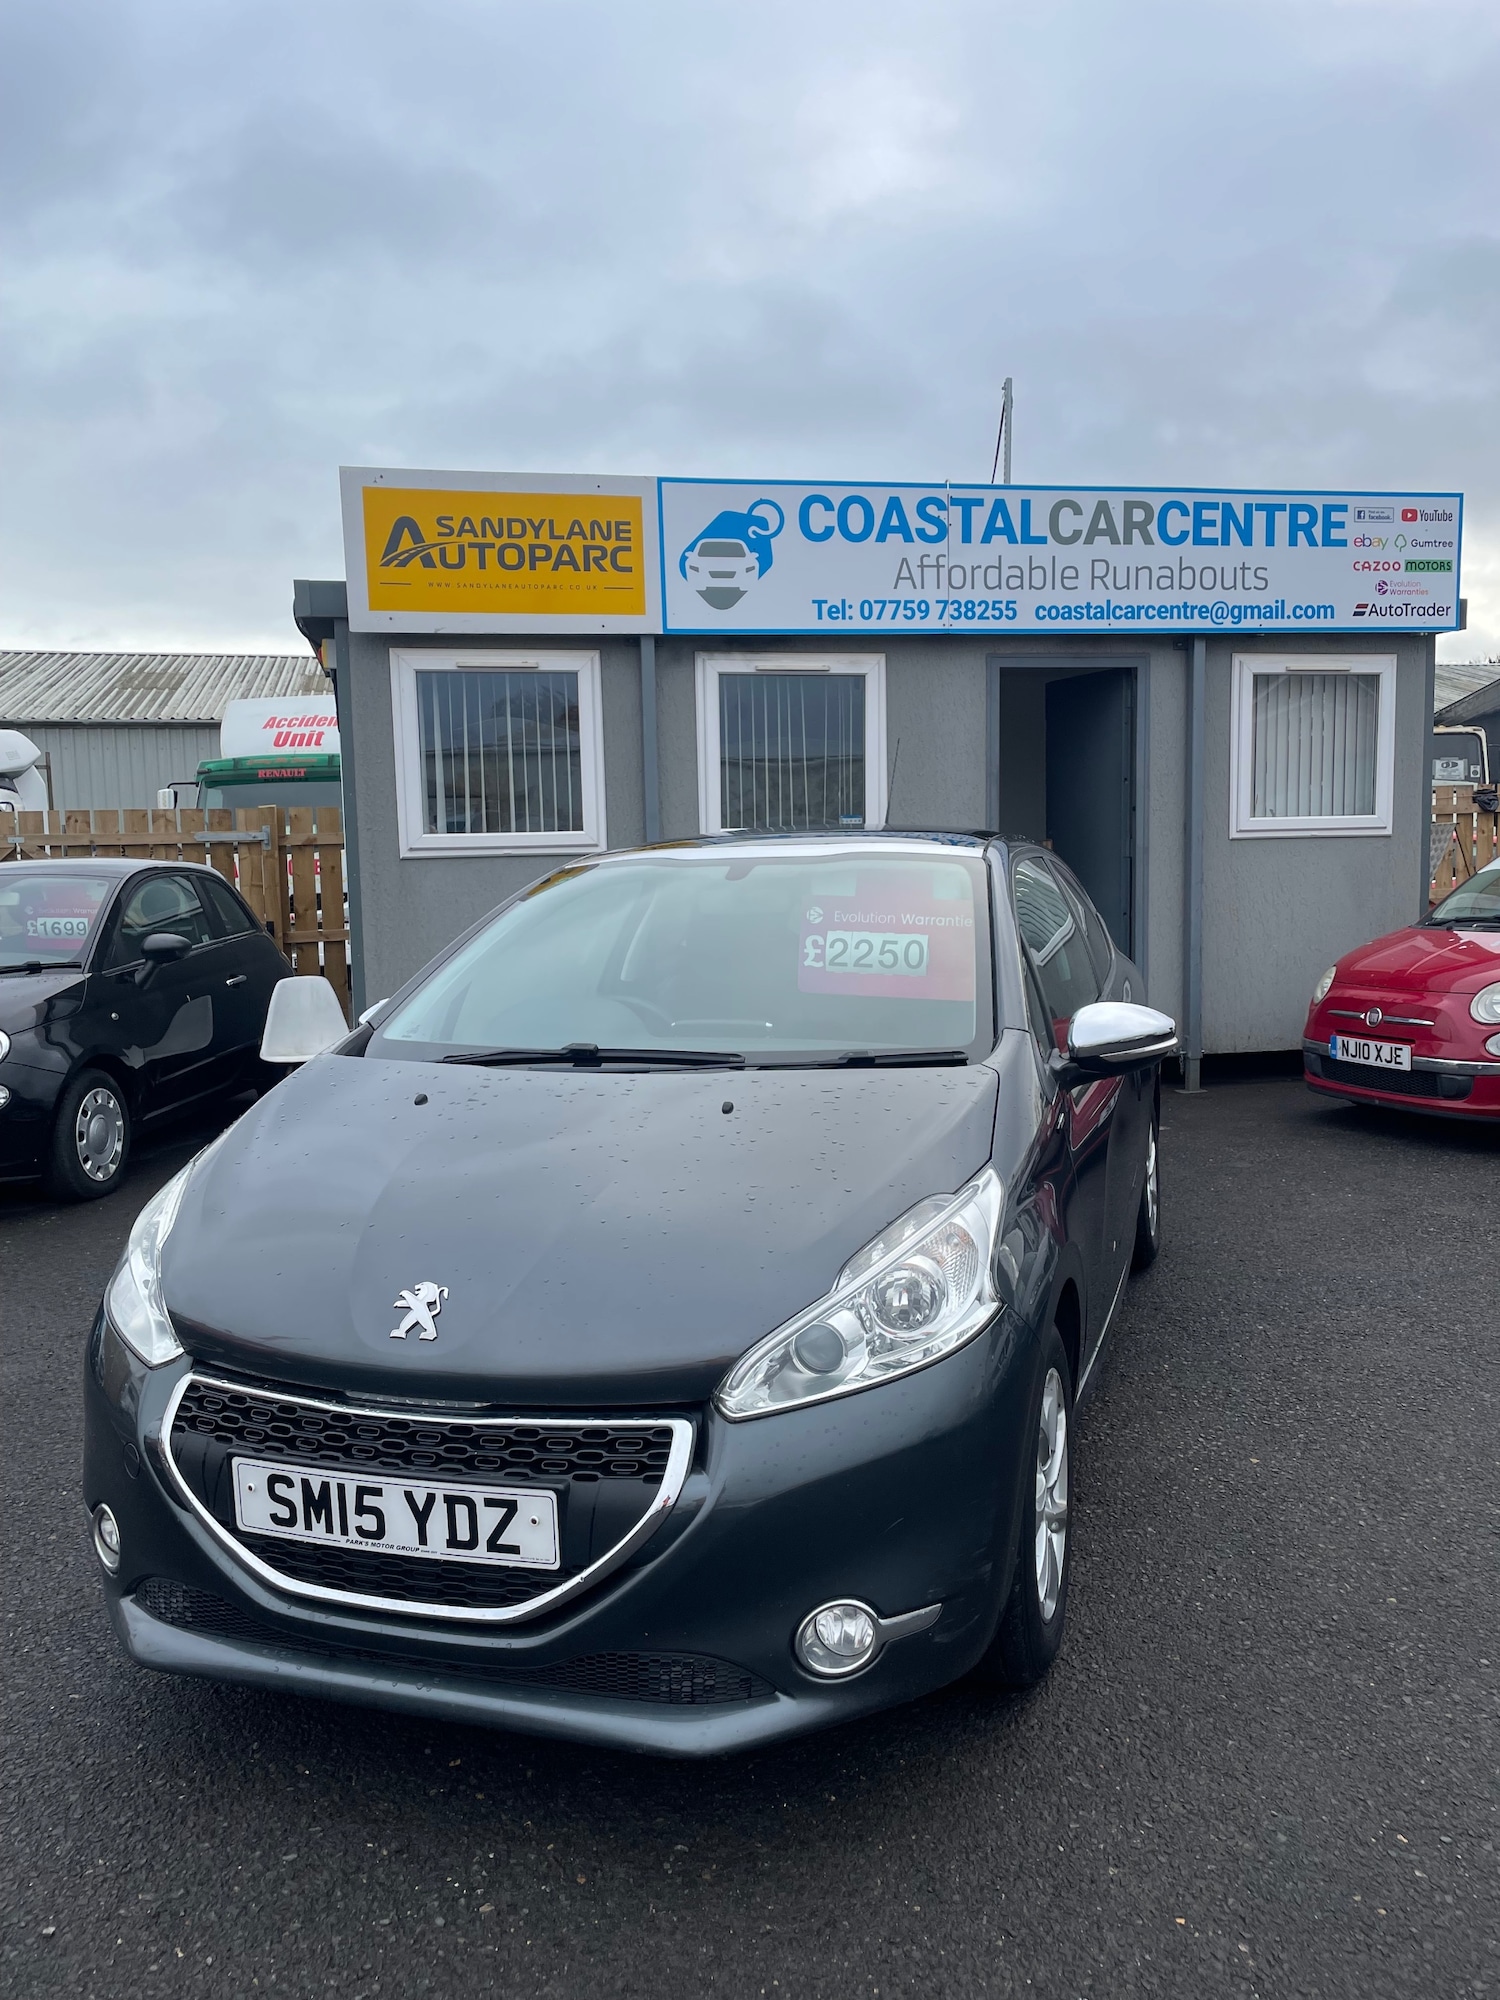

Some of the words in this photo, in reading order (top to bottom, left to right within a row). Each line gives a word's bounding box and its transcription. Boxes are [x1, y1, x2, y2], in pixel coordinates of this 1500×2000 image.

[1420, 509, 1453, 522] YouTube
[435, 516, 632, 541] SANDYLANE
[380, 516, 633, 573] AUTOPARC
[1353, 534, 1389, 551] ebay
[1411, 539, 1453, 548] Gumtree
[893, 554, 1079, 591] Affordable
[1090, 556, 1269, 591] Runabouts
[1353, 561, 1401, 572] CAZOO
[1406, 561, 1452, 571] MOTORS
[812, 599, 853, 620] Tel:
[859, 599, 930, 621] 07759
[936, 600, 1017, 621] 738255
[1035, 599, 1335, 625] coastalcarcentre@gmail.com
[1368, 602, 1451, 617] AutoTrader
[262, 714, 337, 729] Acciden
[273, 730, 325, 748] Unit
[257, 768, 306, 778] RENAULT
[834, 911, 896, 924] Evolution
[901, 913, 973, 927] Warrantie
[27, 920, 87, 937] £1699
[803, 934, 925, 970] £2250
[1341, 1039, 1371, 1061] NJ10
[1374, 1044, 1404, 1066] XJE
[266, 1473, 386, 1541] SM15
[403, 1489, 521, 1555] YDZ
[345, 1538, 369, 1547] PARK'S
[370, 1542, 395, 1550] MOTOR
